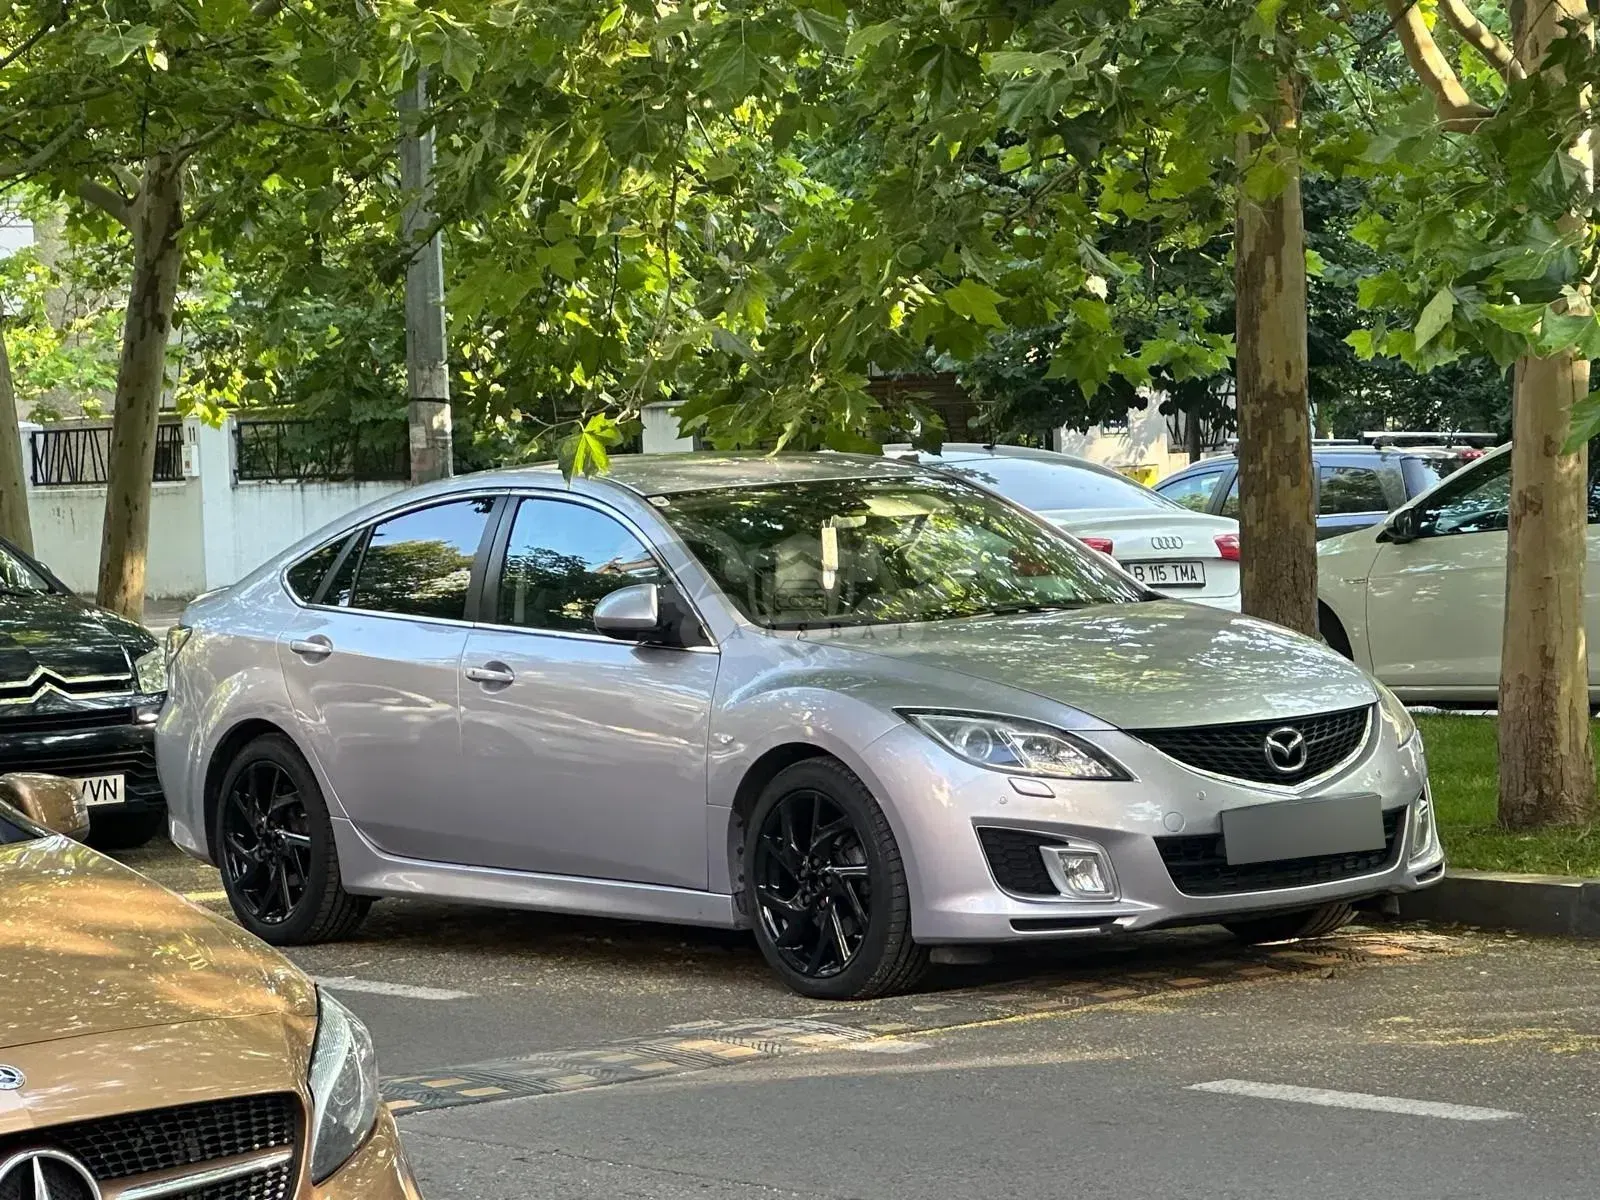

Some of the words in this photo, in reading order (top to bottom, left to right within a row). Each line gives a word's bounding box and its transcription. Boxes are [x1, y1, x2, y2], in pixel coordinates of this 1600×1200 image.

[188, 426, 196, 442] 11
[1134, 566, 1145, 581] B
[1149, 565, 1167, 581] 115
[1172, 564, 1197, 581] TMA
